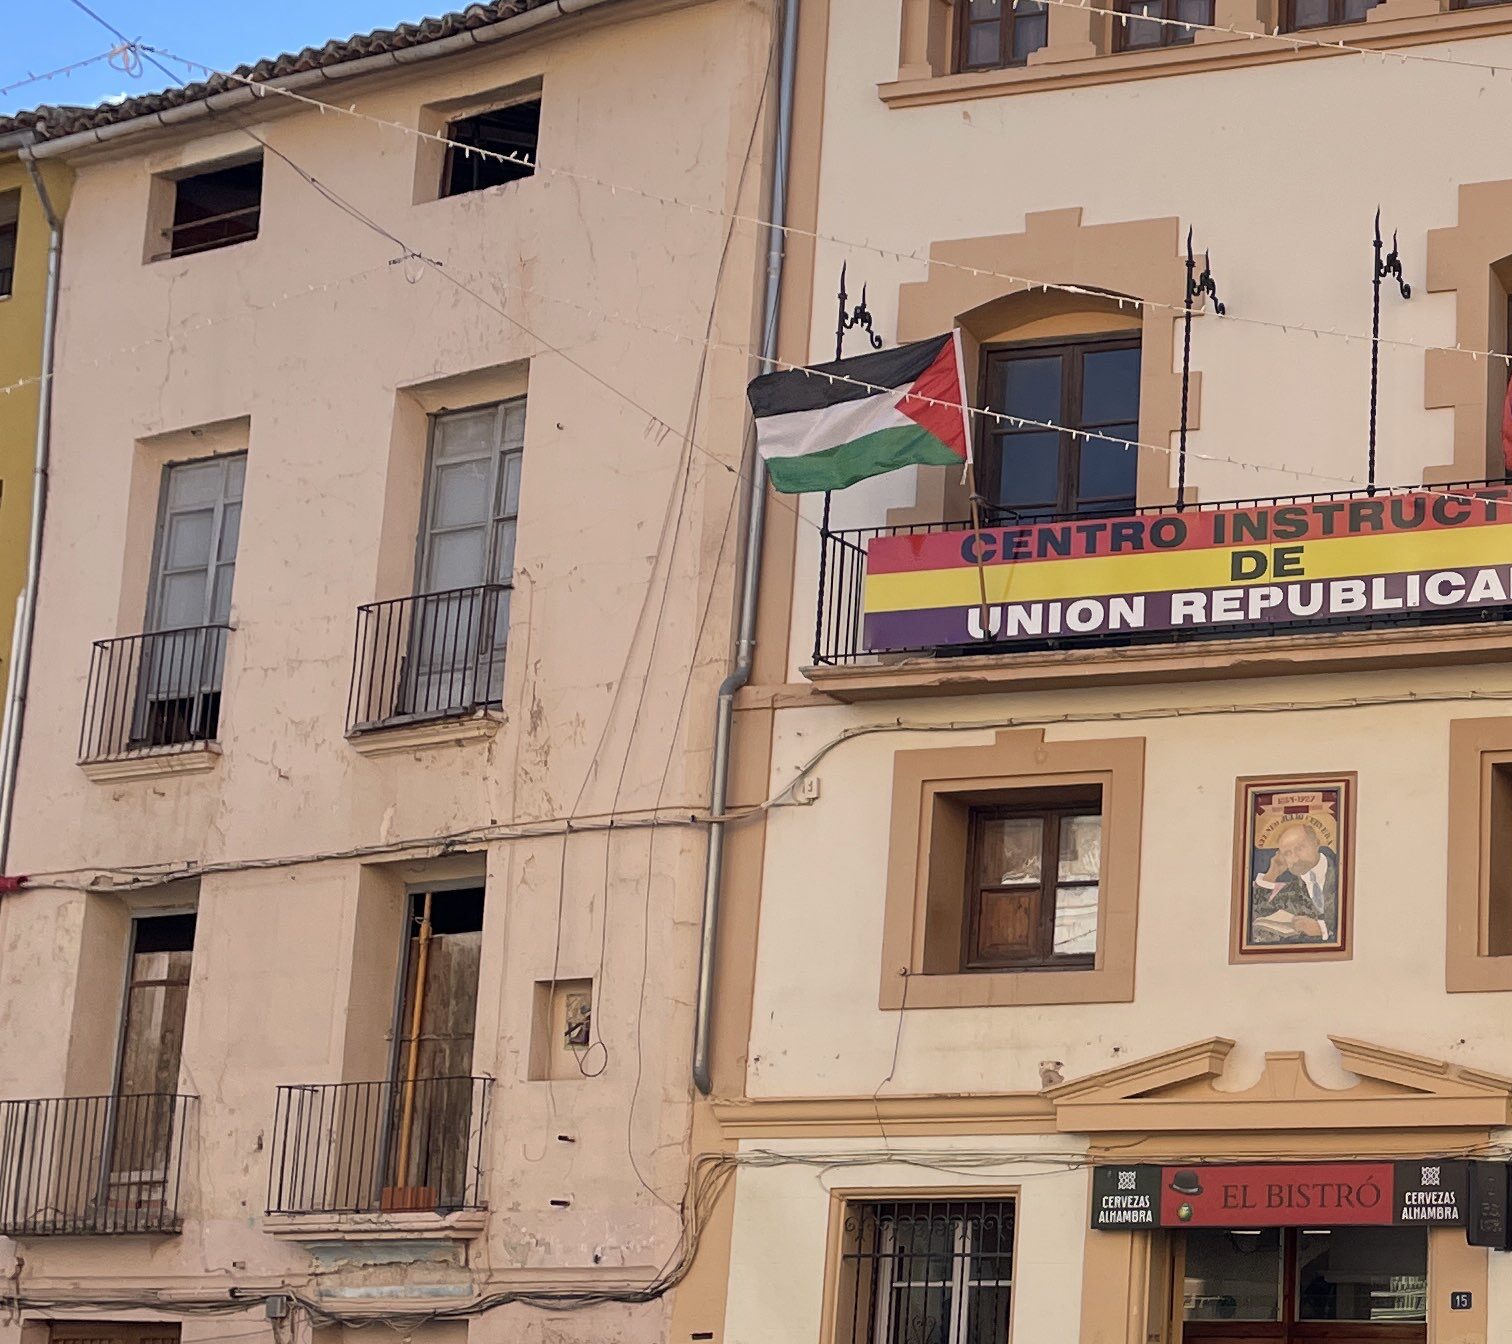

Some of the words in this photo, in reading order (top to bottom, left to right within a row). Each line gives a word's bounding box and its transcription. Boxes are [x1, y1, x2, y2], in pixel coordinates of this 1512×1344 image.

[960, 517, 1187, 564] CENTRO
[1230, 546, 1304, 581] DE
[967, 596, 1145, 640] UNION
[1222, 1184, 1257, 1209] EL
[1266, 1175, 1381, 1209] BISTRÓ
[1405, 1191, 1456, 1205] CERVEZAS
[1102, 1195, 1150, 1208] CERVEZAS
[1098, 1210, 1153, 1223] ALHAMBRA
[1401, 1206, 1459, 1220] ALHAMBRA
[1456, 1294, 1468, 1307] 15
